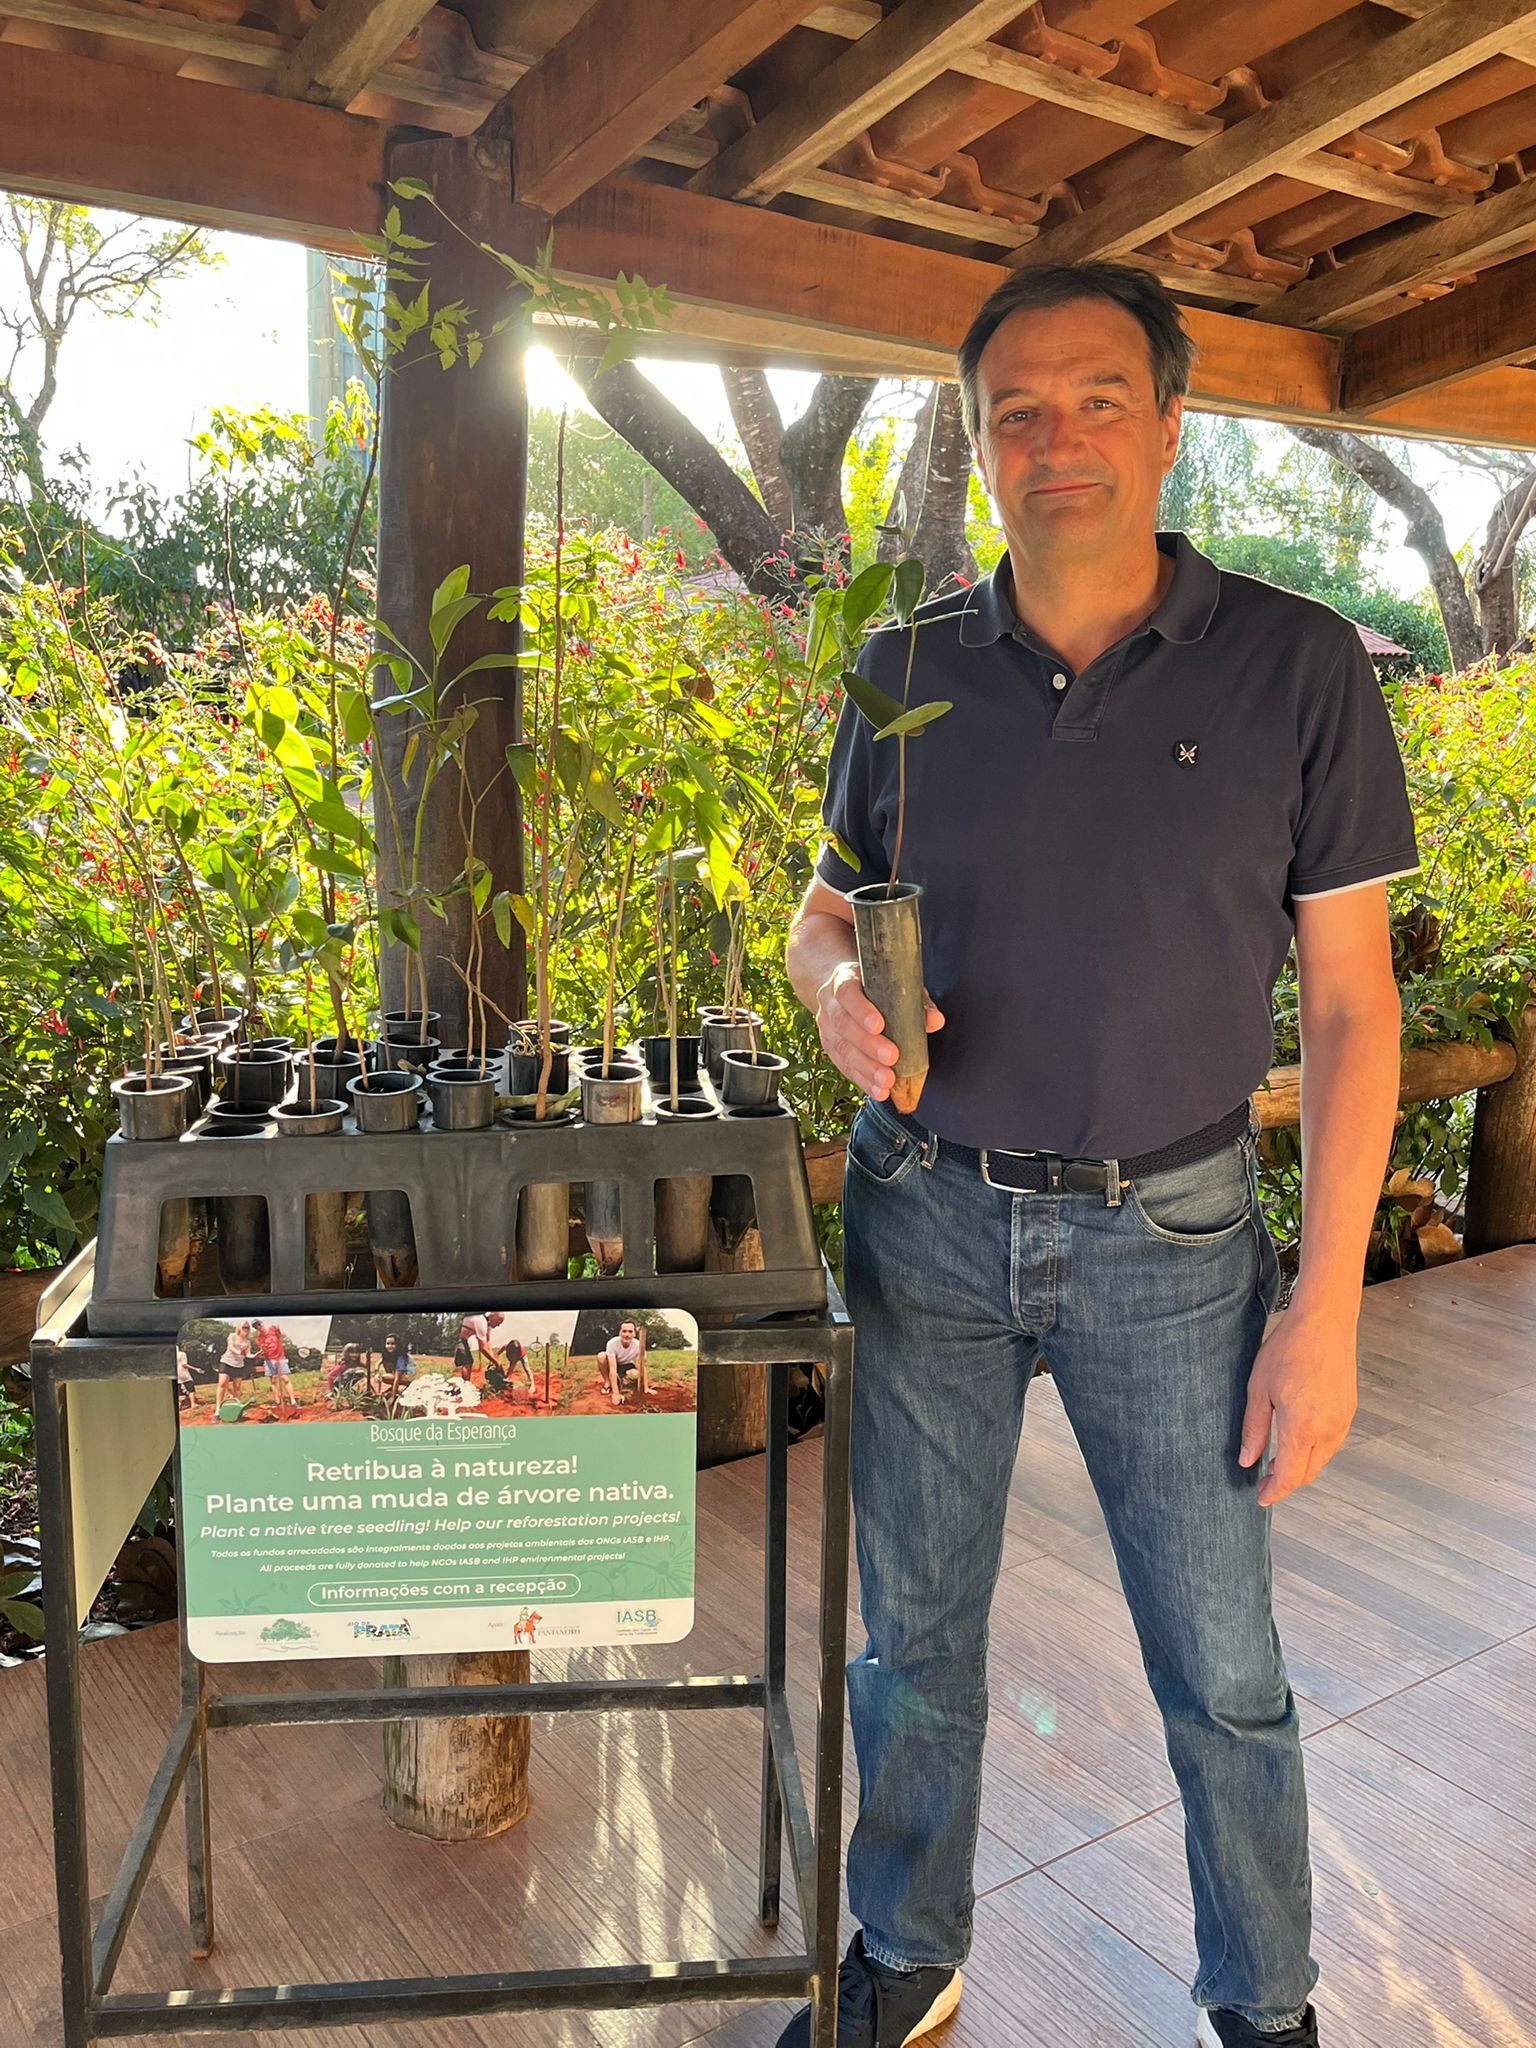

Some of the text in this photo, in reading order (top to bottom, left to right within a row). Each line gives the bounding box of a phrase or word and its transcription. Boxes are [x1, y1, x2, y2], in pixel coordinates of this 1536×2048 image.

[371, 1422, 516, 1444] Bosque da Esperança
[307, 1455, 578, 1482] Retribua à natureza!
[207, 1480, 674, 1514] Plante uma muda de árvore nativa.
[200, 1511, 681, 1538] Plant a native tree seedling! Help our reforestation projects!
[211, 1550, 238, 1558] Todos
[288, 1546, 346, 1555] arrecadados
[347, 1546, 364, 1554] são
[366, 1544, 431, 1554] integralmente
[433, 1542, 466, 1550] doados
[486, 1540, 522, 1550] projetos
[525, 1538, 576, 1548] ambientais
[622, 1536, 644, 1544] IASB
[653, 1534, 672, 1542] IHP.
[274, 1564, 316, 1573] proceeds
[336, 1562, 356, 1571] fully
[357, 1560, 396, 1569] donated
[410, 1560, 430, 1568] help
[459, 1558, 480, 1566] IASB
[482, 1556, 500, 1564] and
[502, 1556, 518, 1564] IHP
[520, 1553, 586, 1563] environmental
[587, 1552, 626, 1562] projects!
[322, 1578, 566, 1600] Informações com a recepção
[617, 1609, 656, 1623] IASB
